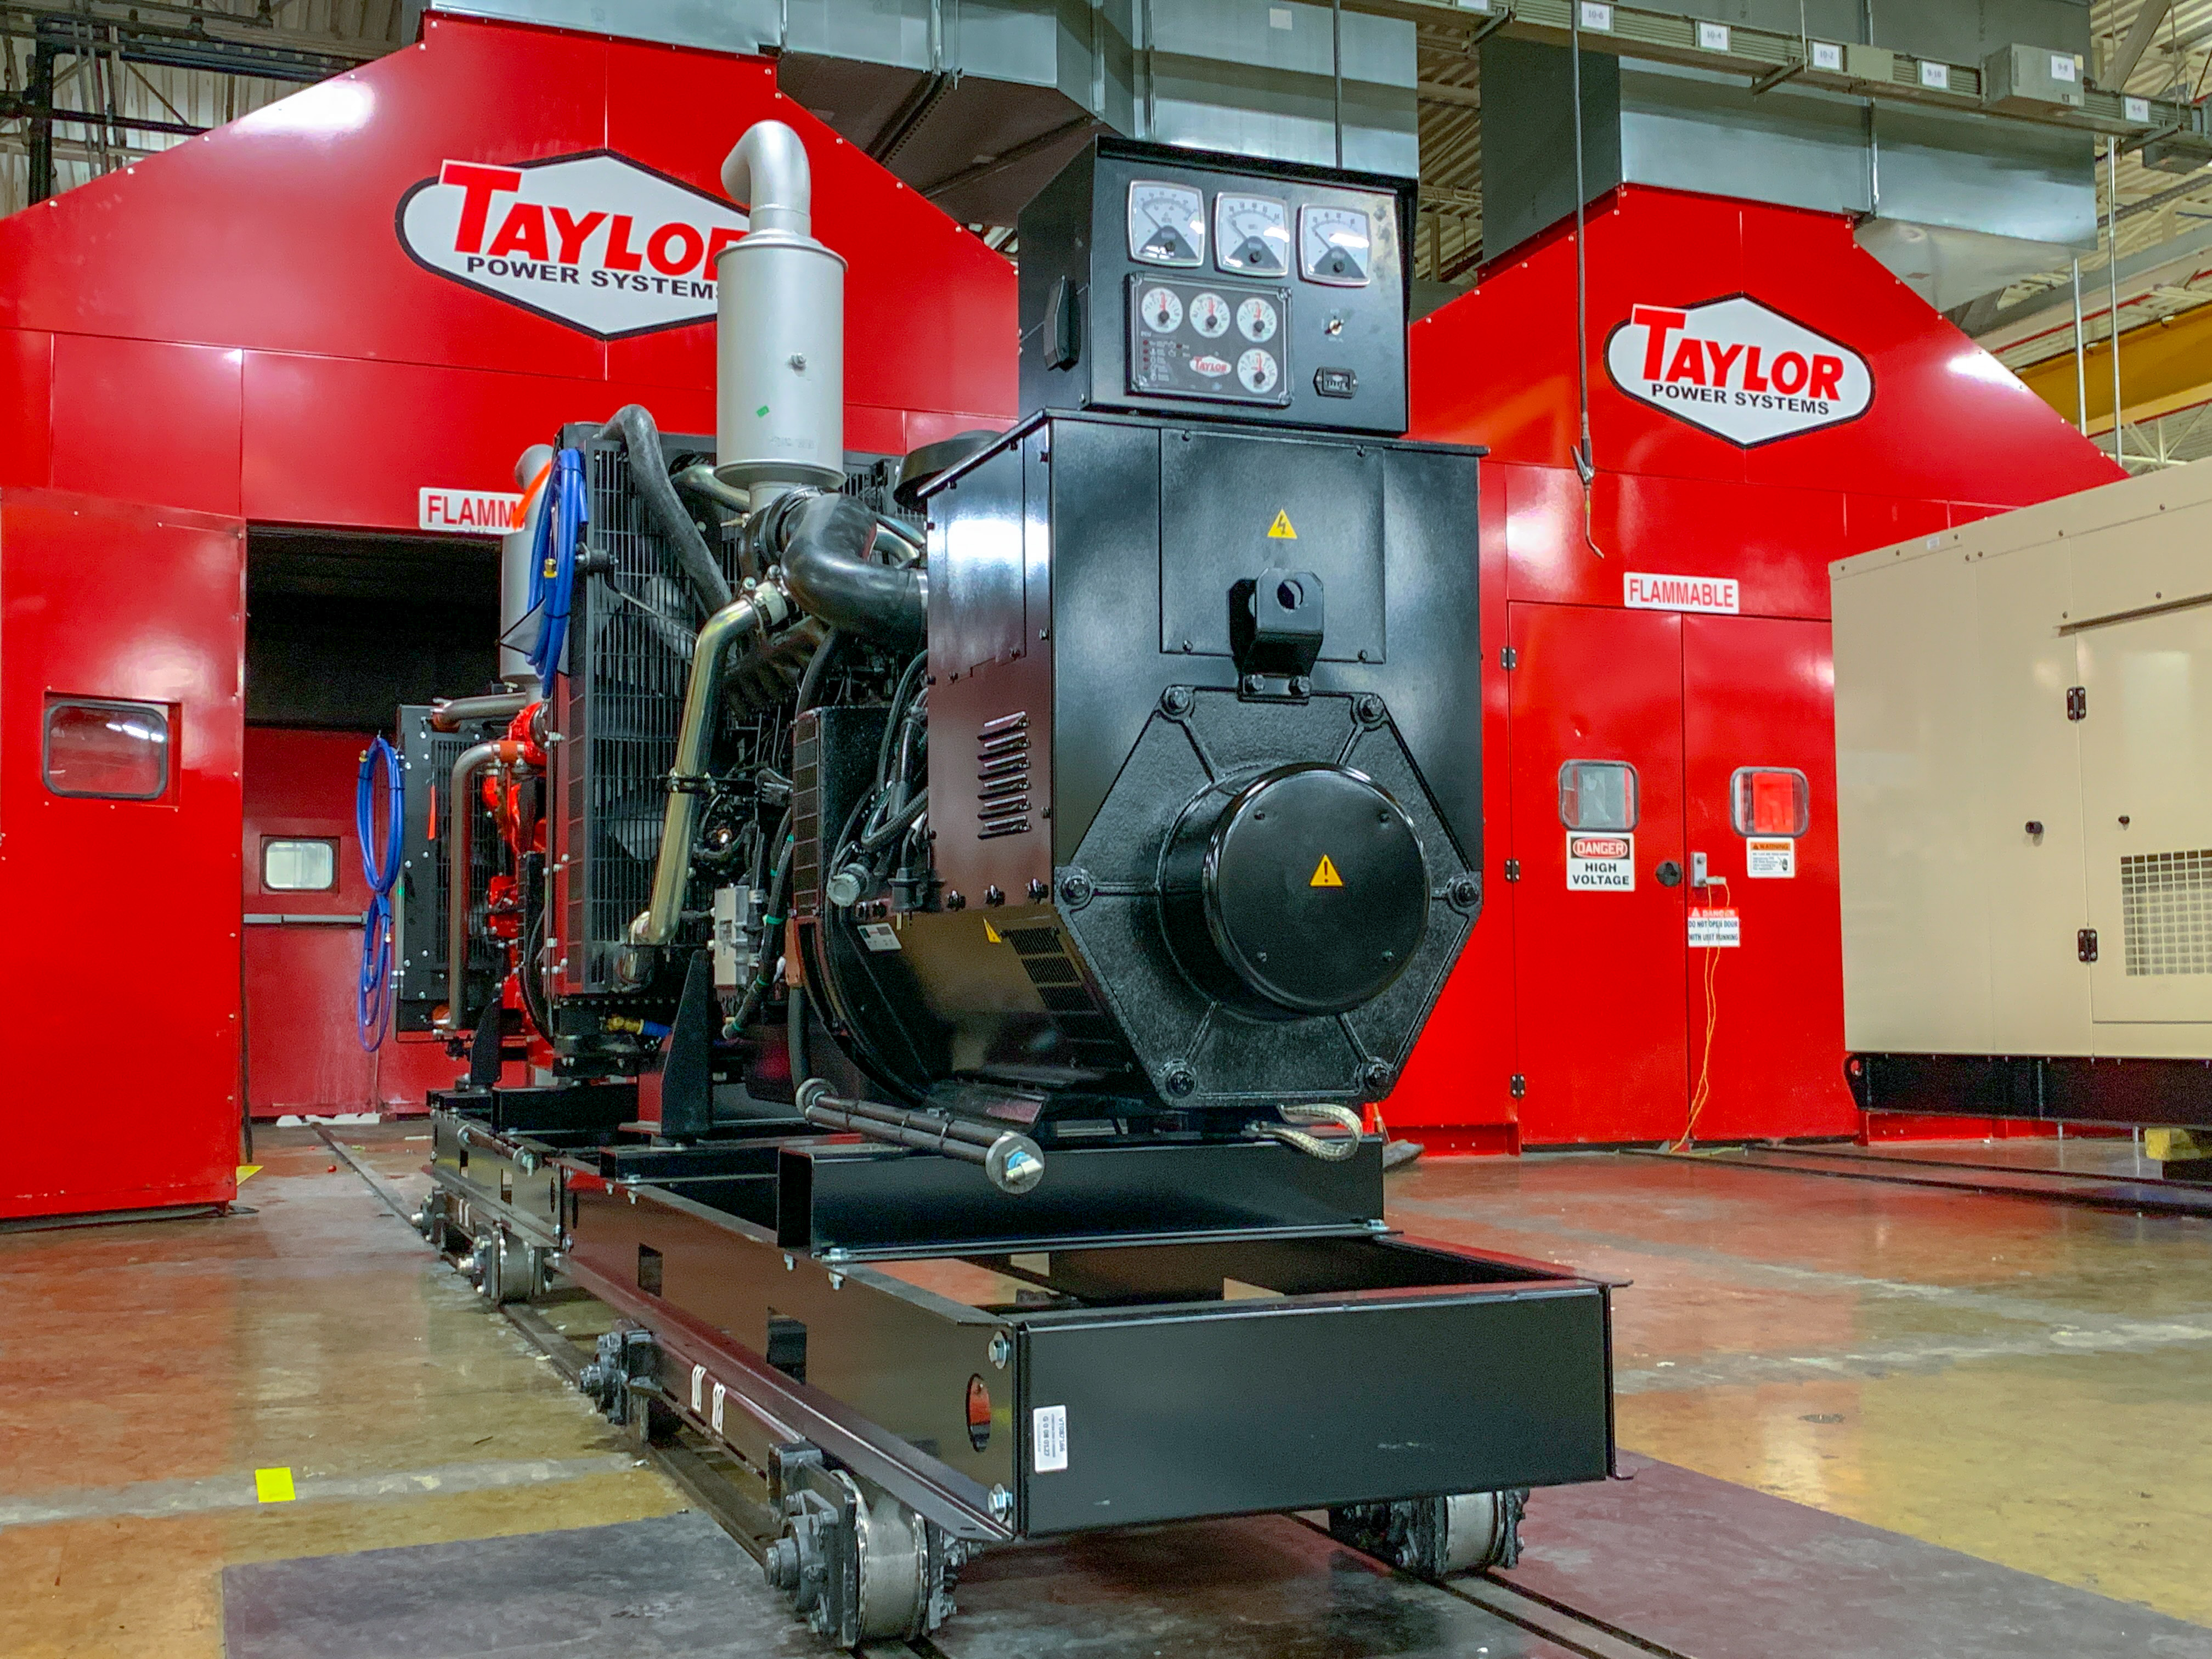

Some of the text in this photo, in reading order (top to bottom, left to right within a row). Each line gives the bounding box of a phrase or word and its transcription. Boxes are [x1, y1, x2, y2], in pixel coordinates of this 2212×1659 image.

[466, 256, 718, 300] POWER SYSTEM
[1193, 356, 1227, 372] TAYLOR
[1633, 307, 1844, 402] TAYLOR
[1651, 383, 1830, 415] POWER SYSTEMS
[427, 495, 524, 529] FLAMM
[1629, 578, 1734, 608] FLAMMABLE
[1577, 842, 1624, 855] DANGER
[1572, 874, 1630, 885] VOLTAGE
[1585, 862, 1617, 873] HIGH
